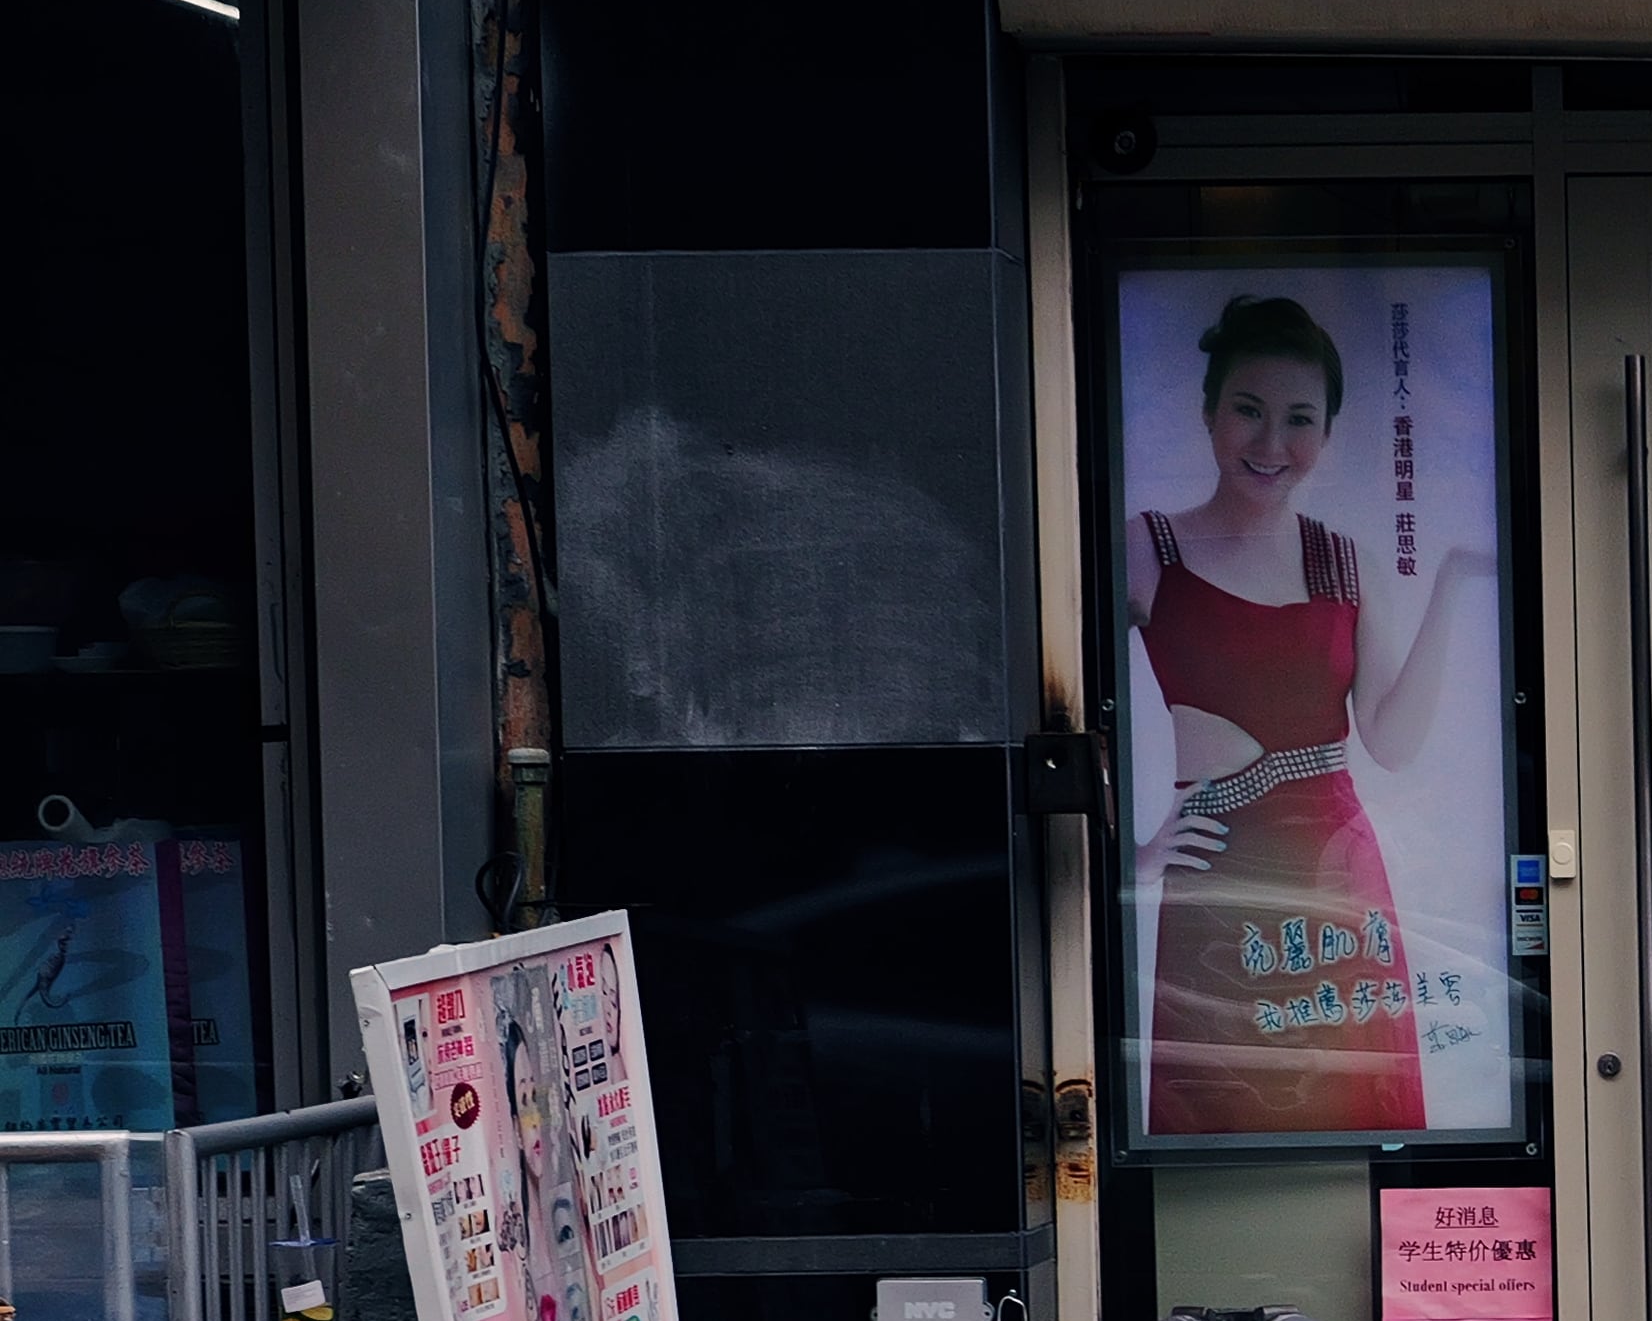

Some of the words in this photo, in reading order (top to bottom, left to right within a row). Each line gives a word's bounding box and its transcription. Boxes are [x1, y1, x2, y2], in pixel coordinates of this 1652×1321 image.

[1395, 512, 1417, 577] 莊思敏
[1519, 914, 1541, 923] VISA
[0, 1027, 47, 1053] ERICAN
[48, 1024, 107, 1051] GINSENG
[108, 1022, 137, 1049] TEA
[191, 1020, 219, 1045] TEA
[1434, 1205, 1500, 1229] 好消息
[1398, 1239, 1538, 1263] 学生特价優惠
[1400, 1279, 1448, 1292] Student
[1451, 1278, 1495, 1295] special
[1498, 1278, 1536, 1291] offers
[904, 1301, 956, 1319] NYC
